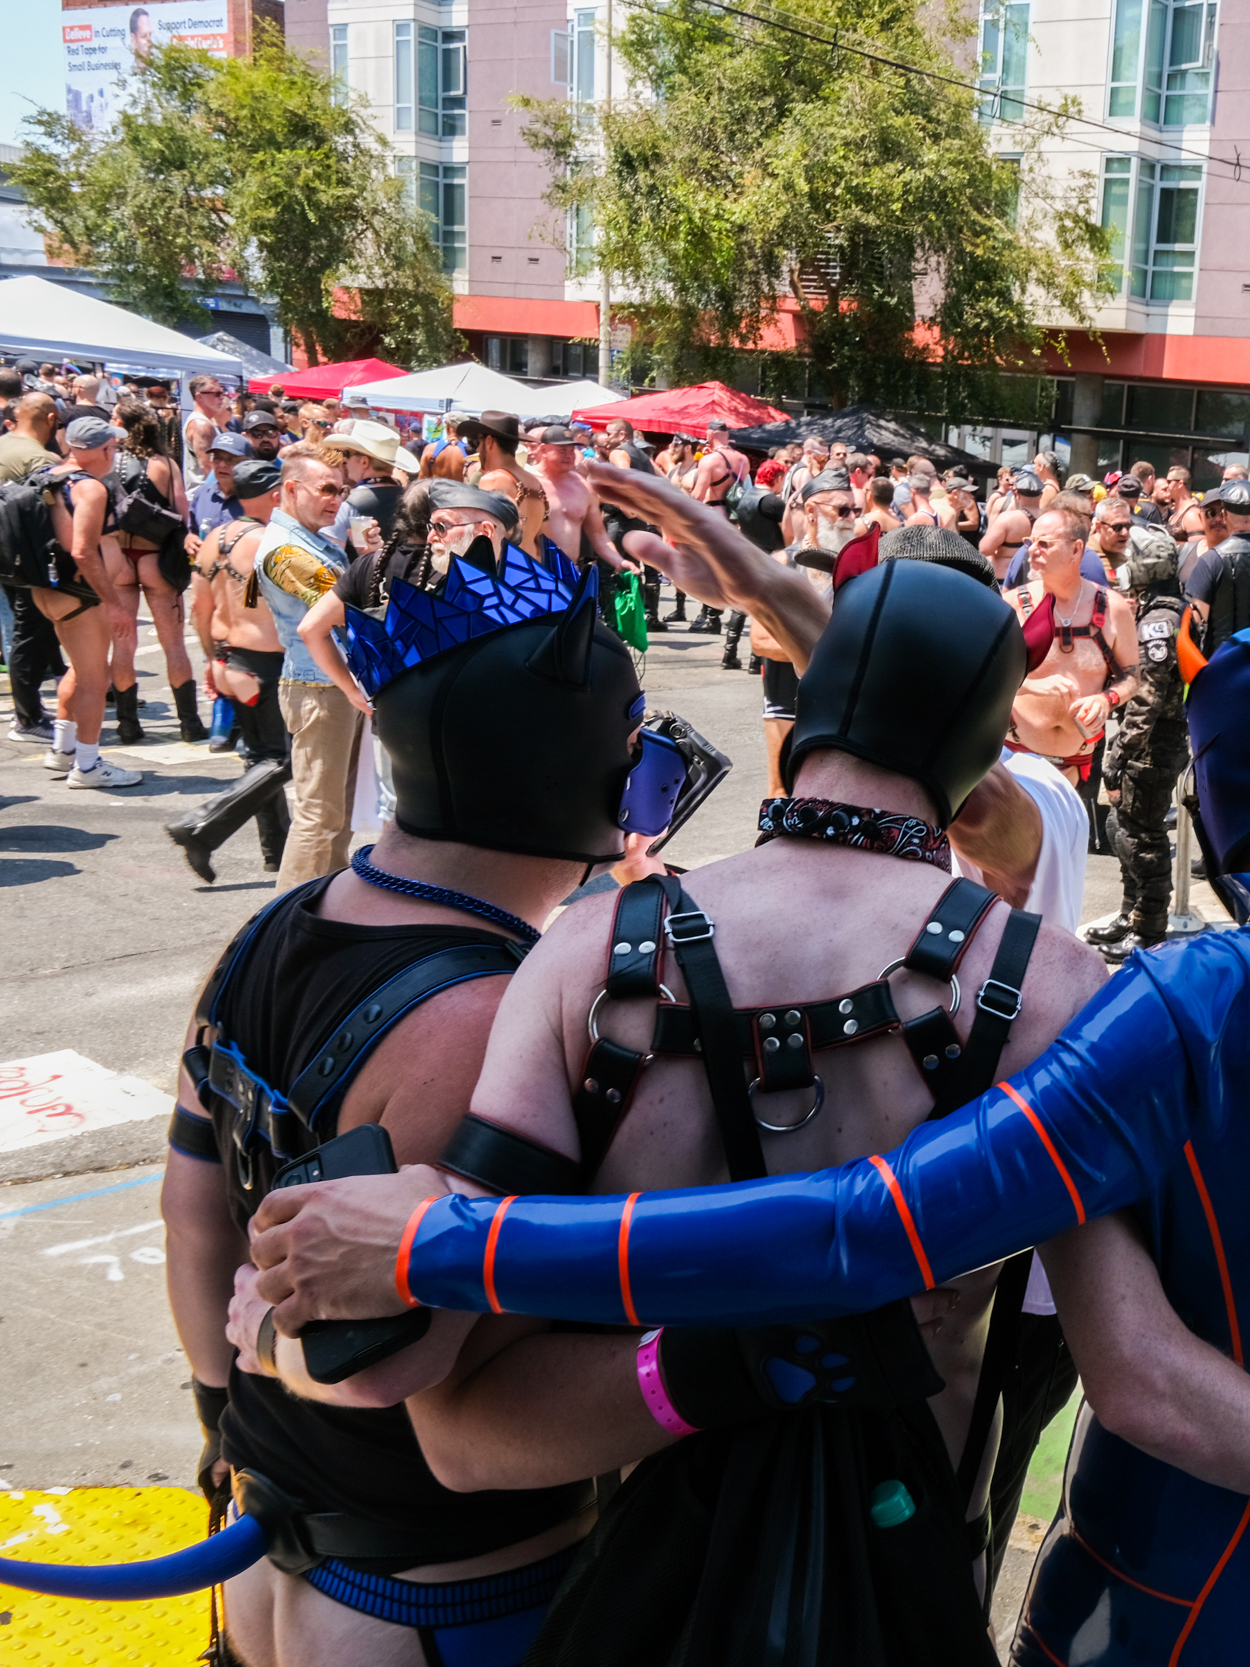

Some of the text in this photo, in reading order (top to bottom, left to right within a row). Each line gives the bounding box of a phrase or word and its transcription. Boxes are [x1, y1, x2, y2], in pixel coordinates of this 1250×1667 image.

[158, 17, 224, 32] Support Democrat
[65, 26, 126, 40] Believe in Cutting
[67, 44, 108, 57] Red Tape for
[67, 61, 122, 72] Small Businesses
